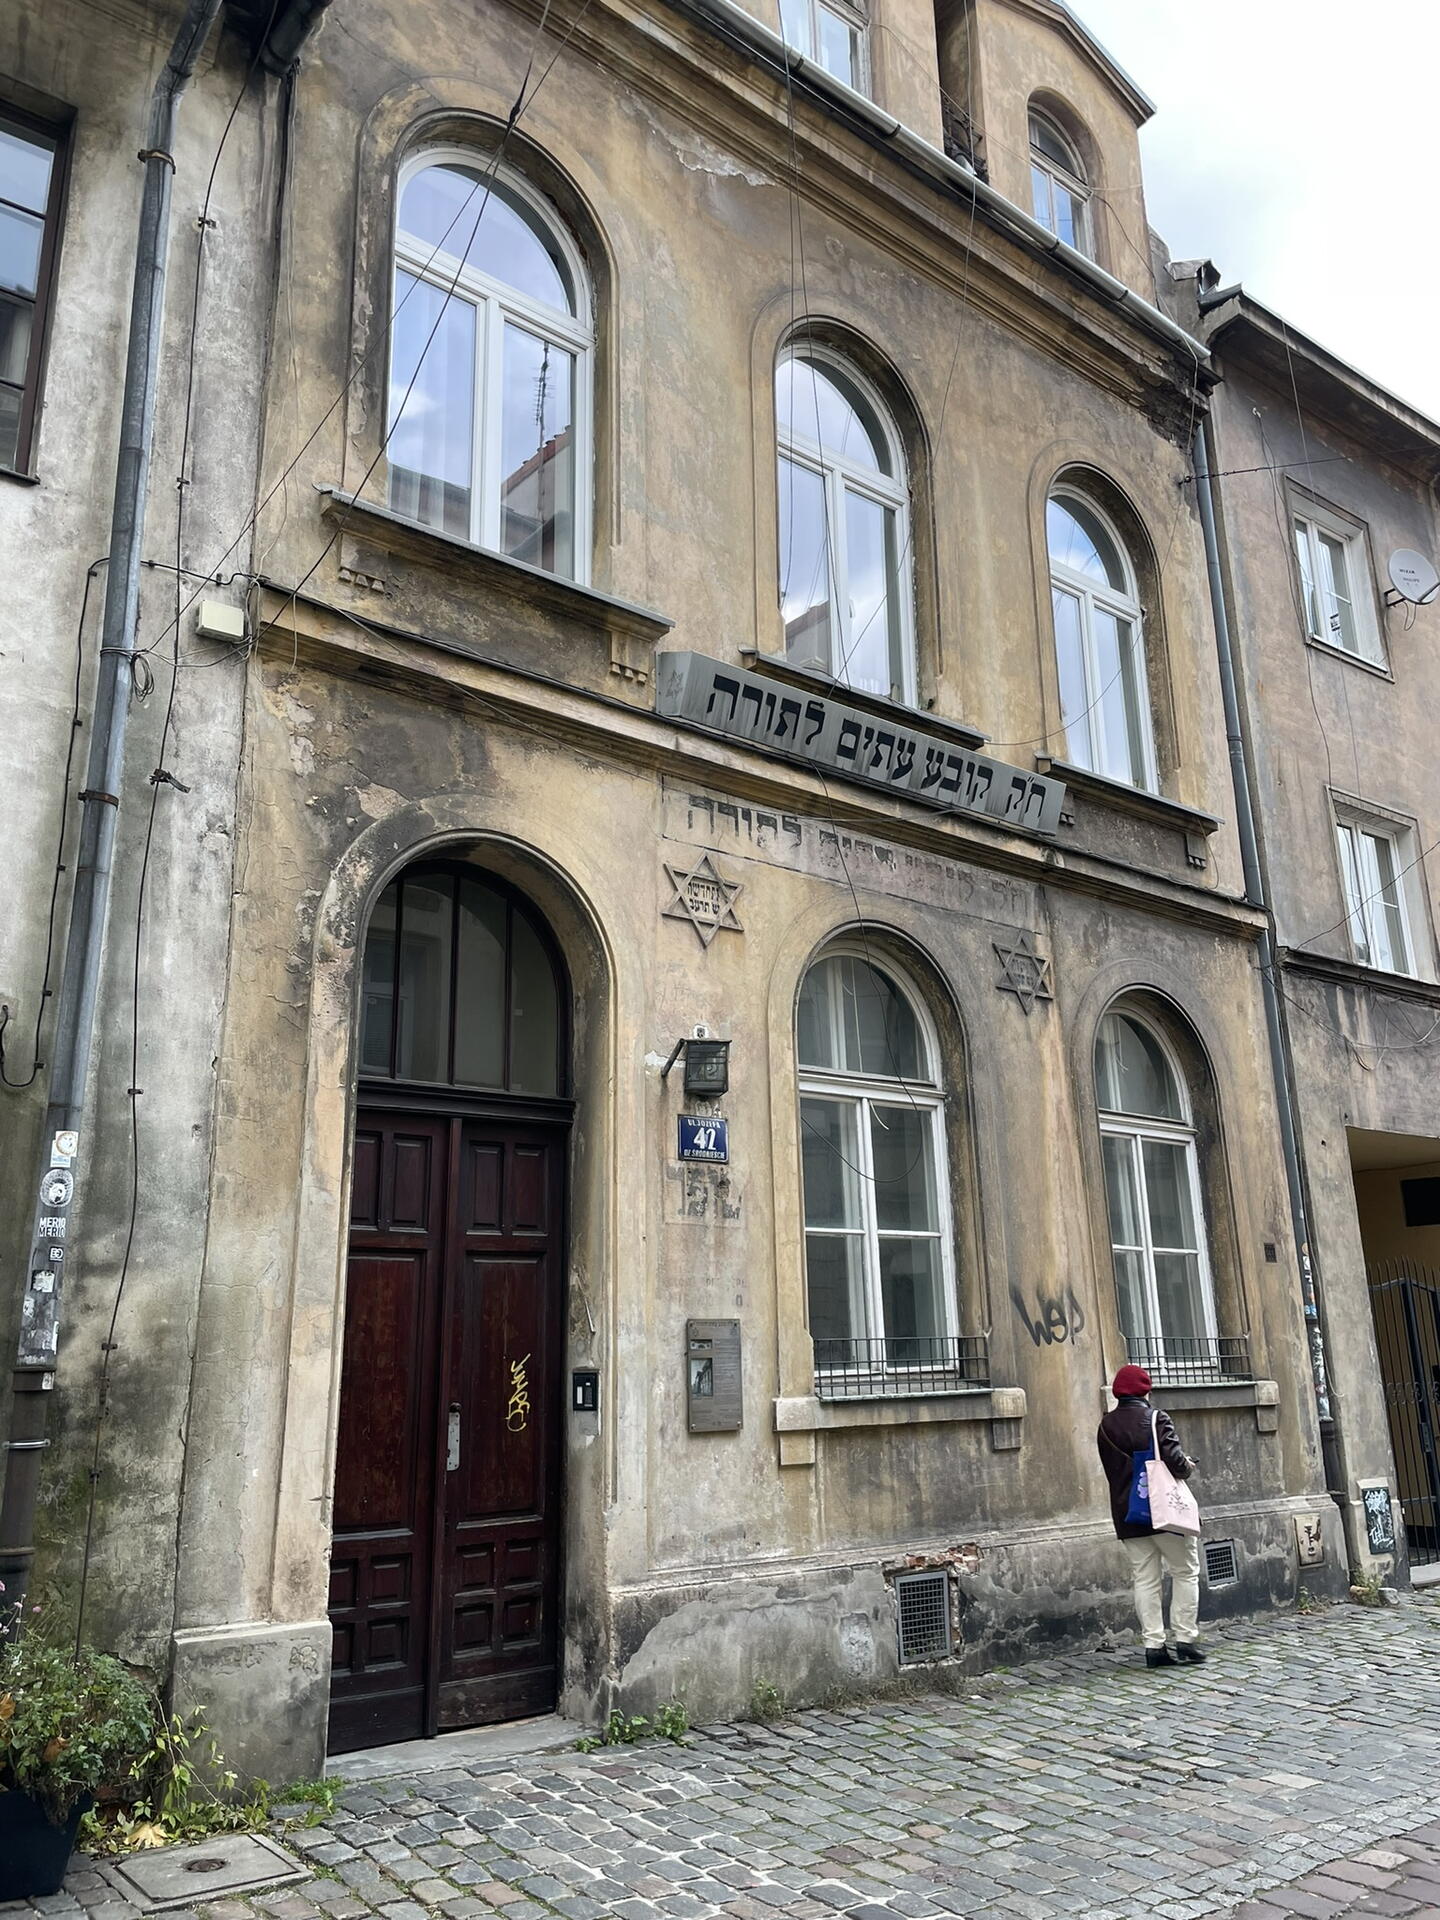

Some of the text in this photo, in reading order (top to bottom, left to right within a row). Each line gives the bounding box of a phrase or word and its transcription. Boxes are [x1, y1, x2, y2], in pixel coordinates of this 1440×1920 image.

[706, 673, 825, 745] לתורה
[836, 718, 916, 781] עתים
[920, 747, 993, 803] קובע
[694, 1127, 717, 1150] 42
